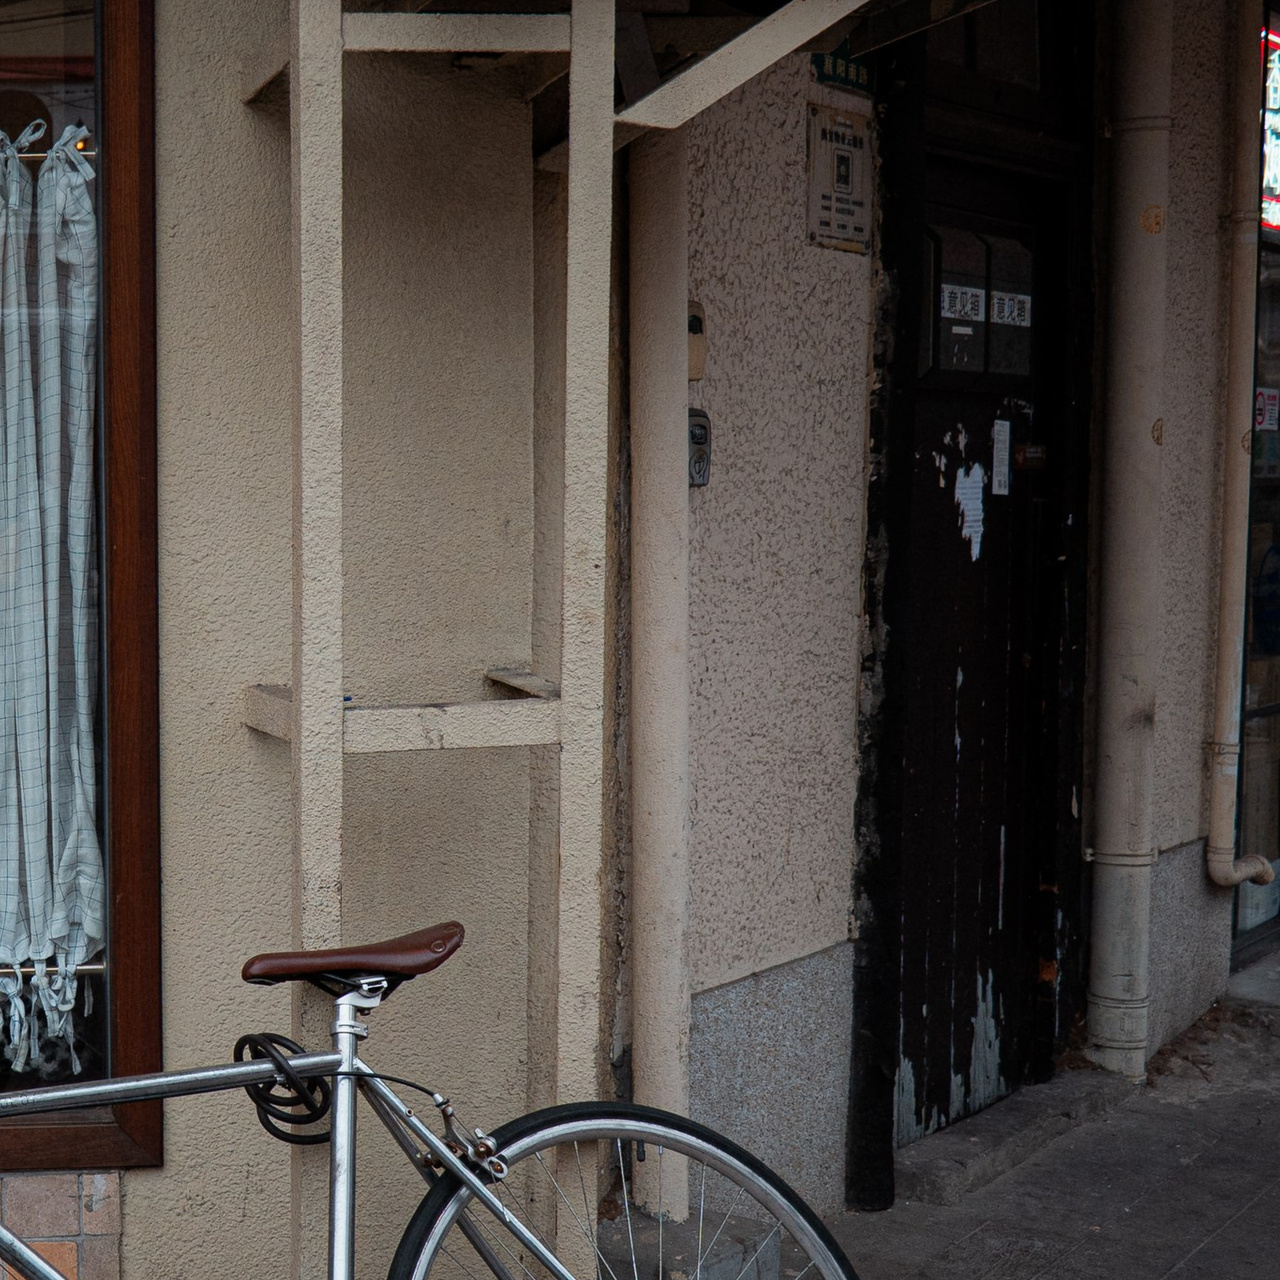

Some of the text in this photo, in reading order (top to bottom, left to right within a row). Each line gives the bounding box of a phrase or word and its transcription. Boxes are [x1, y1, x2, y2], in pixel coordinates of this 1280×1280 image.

[947, 289, 980, 317] 意见箱
[995, 296, 1026, 323] 意见箱
